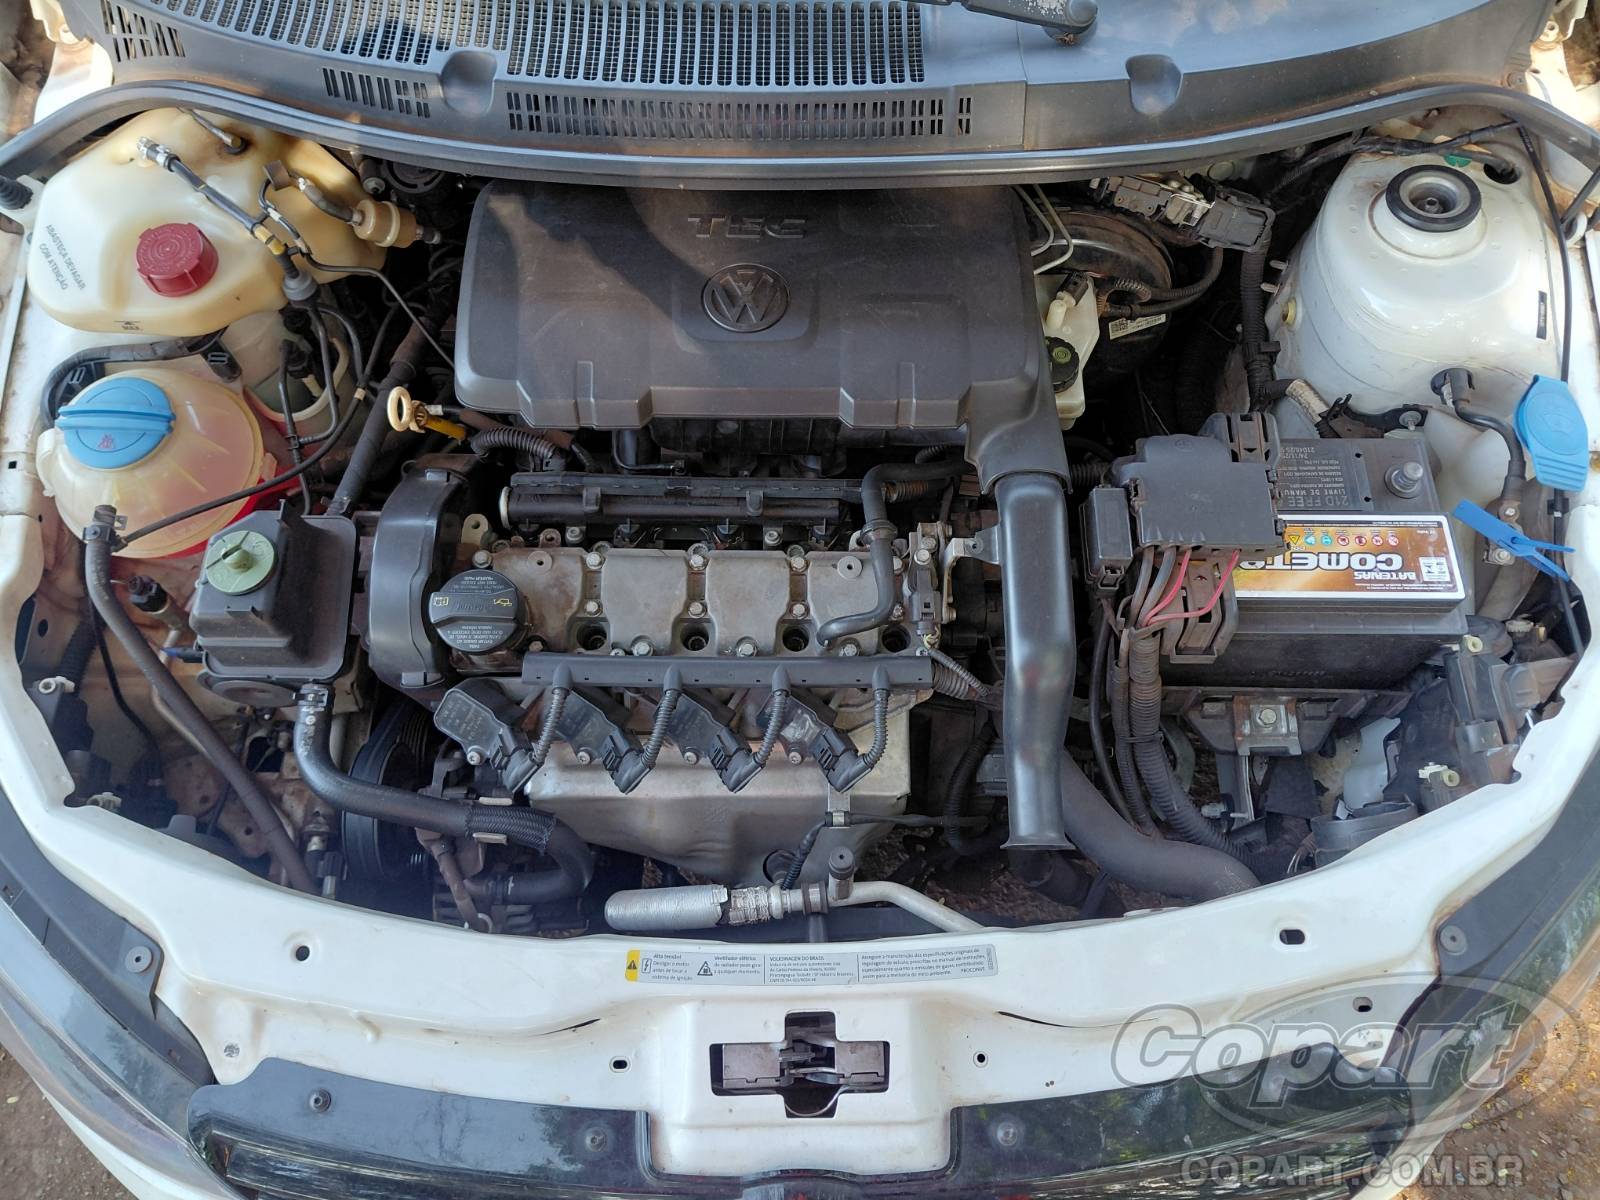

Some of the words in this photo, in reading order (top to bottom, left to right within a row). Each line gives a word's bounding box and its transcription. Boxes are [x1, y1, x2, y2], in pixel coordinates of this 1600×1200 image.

[687, 216, 806, 238] TEC
[39, 243, 52, 259] COM
[47, 259, 68, 291] ATENÇÃO
[64, 257, 86, 291] DEVAGAR
[1288, 496, 1321, 507] FREE
[1354, 571, 1416, 580] BATERIAS
